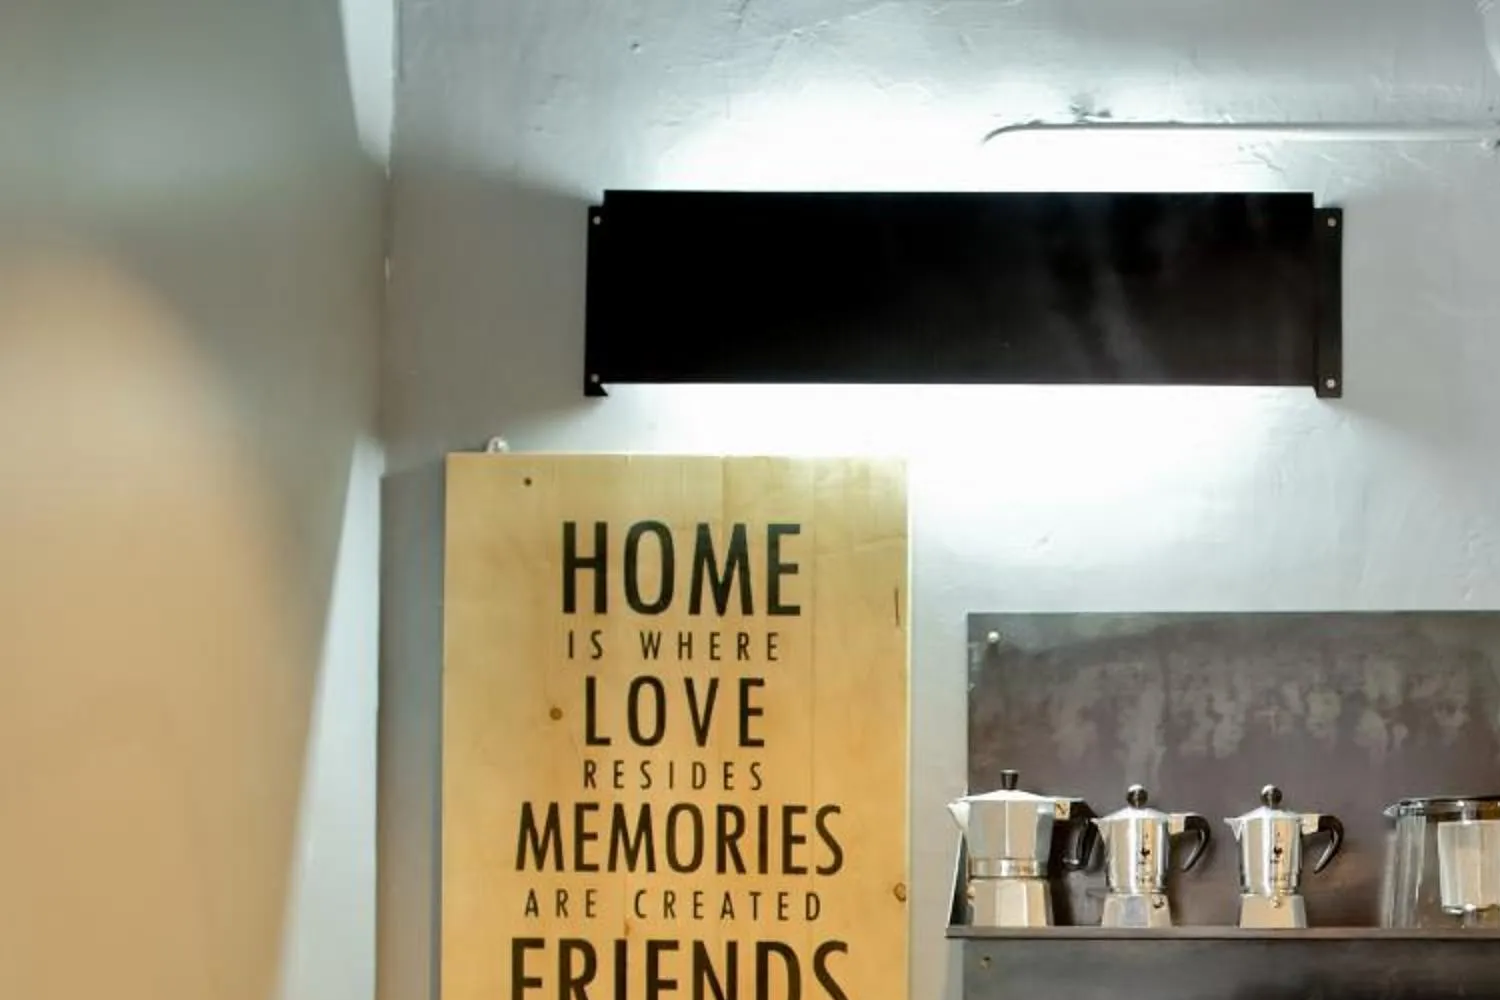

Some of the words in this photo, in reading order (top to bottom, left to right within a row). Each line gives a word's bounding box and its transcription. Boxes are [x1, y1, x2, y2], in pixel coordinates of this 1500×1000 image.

[562, 521, 800, 617] HOME
[569, 630, 602, 660] IS
[640, 631, 777, 661] WHERE
[585, 676, 765, 748] LOVE
[584, 759, 762, 790] RESIDES
[516, 801, 843, 876] MEMORIES
[525, 889, 596, 918] ARE
[635, 890, 820, 921] CREATED
